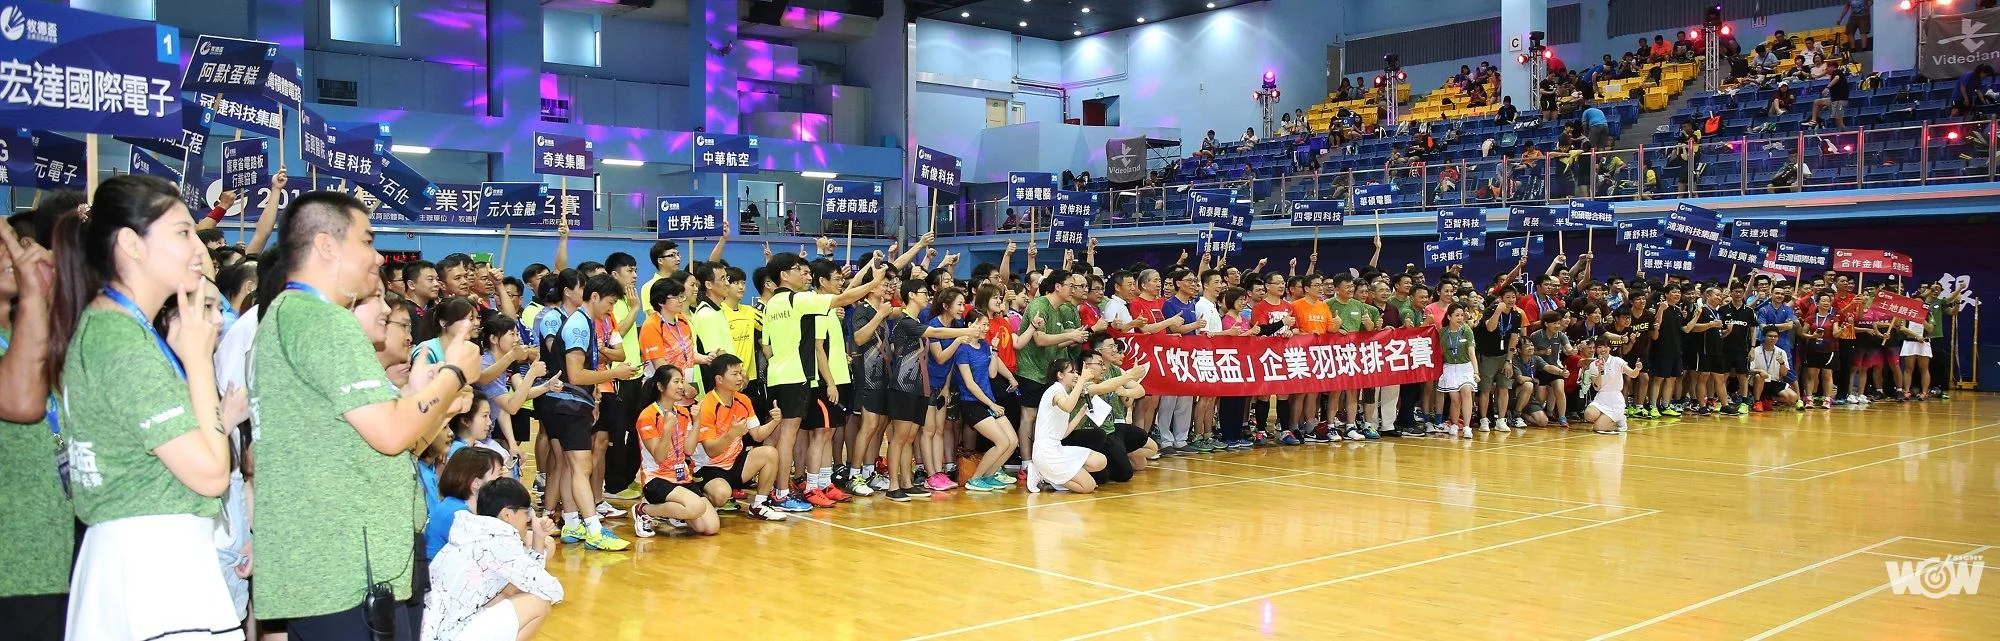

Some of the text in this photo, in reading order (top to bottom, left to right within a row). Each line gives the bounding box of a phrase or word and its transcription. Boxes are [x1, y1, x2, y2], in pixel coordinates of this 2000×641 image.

[163, 34, 172, 55] 1
[1512, 38, 1519, 48] C
[267, 48, 277, 56] 13
[1932, 50, 2000, 66] Videolan
[198, 62, 260, 85] 阿默蛋糕
[0, 58, 174, 117] 宏達國際電子
[200, 93, 281, 129] 冠捷科技集團
[204, 112, 211, 123] 9
[262, 141, 268, 149] 15
[543, 151, 586, 170] 奇美集團
[703, 151, 750, 167] 中華航空
[920, 164, 955, 186] 新像科技
[427, 186, 436, 195] 16
[1015, 187, 1051, 200] 華通電腦
[825, 198, 878, 214] 香港商雅虎
[1359, 194, 1392, 206] 華碩電腦
[487, 201, 537, 217] 元大金融
[1059, 203, 1091, 215] 致伸科技
[1199, 205, 1229, 218] 和泰興業
[667, 214, 715, 231] 世界先進
[1293, 211, 1341, 222] 四零四科技
[1444, 218, 1479, 229] 亞智科技
[1623, 229, 1658, 240] 康舒科技
[1666, 221, 1720, 241] 鴻海科技集團
[1740, 228, 1779, 238] 友達光電
[1431, 250, 1463, 262] 中央銀行
[1777, 252, 1826, 266] 台灣國際航電
[1644, 258, 1693, 270] 穩懋半導體
[1841, 259, 1883, 269] 合作金庫
[1879, 301, 1919, 318] 土地銀行
[1630, 322, 1649, 331] NICE
